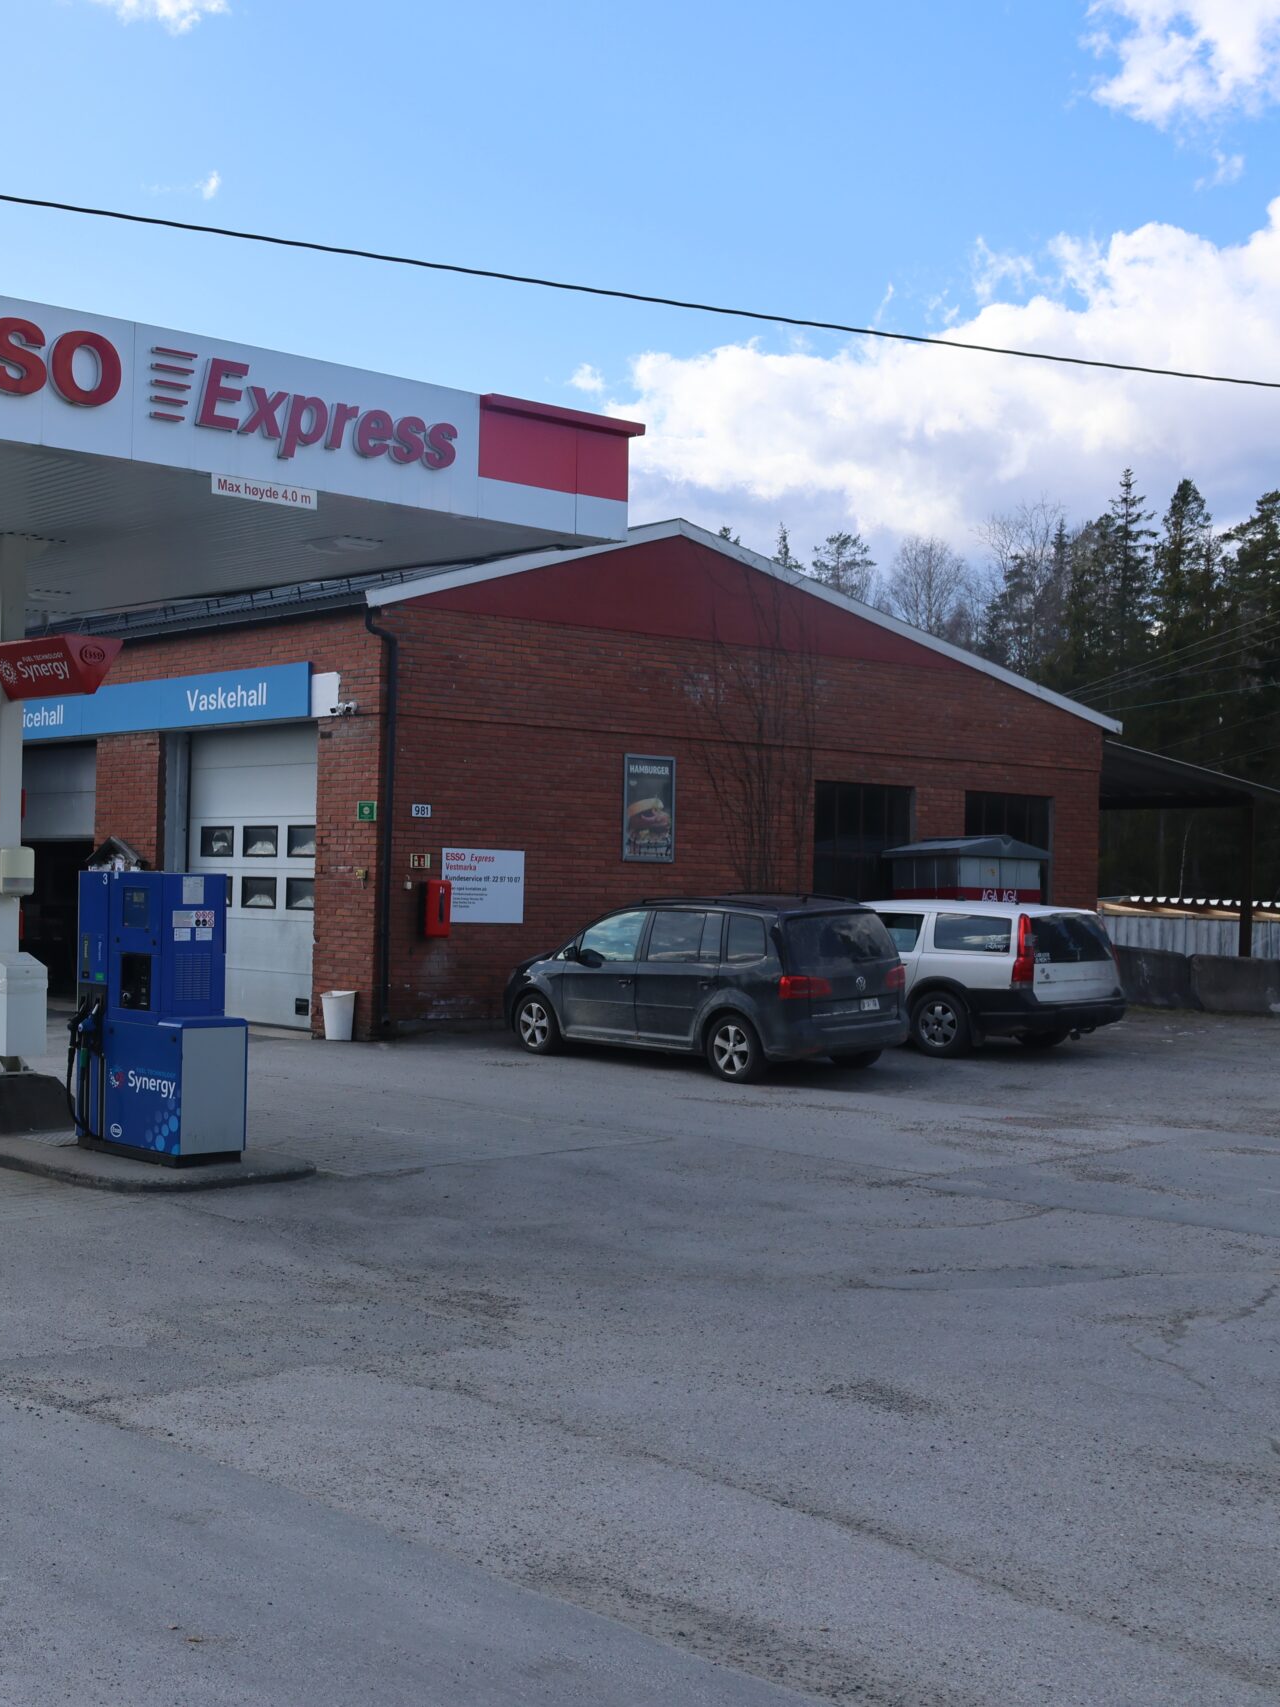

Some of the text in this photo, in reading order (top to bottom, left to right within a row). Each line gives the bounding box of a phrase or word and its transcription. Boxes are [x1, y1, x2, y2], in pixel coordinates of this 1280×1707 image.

[195, 357, 458, 470] Express
[218, 479, 311, 504] Max høyde 4.0 m
[16, 661, 70, 683] Synergy
[186, 683, 268, 712] Vaskehall
[23, 704, 64, 728] icehall
[629, 764, 670, 776] HAMBURGER
[414, 805, 430, 816] 981
[445, 852, 496, 863] ESSO Express
[445, 862, 477, 871] Vestmarka
[102, 873, 109, 885] 3
[981, 889, 998, 902] AGA
[127, 1070, 176, 1099] Synergy
